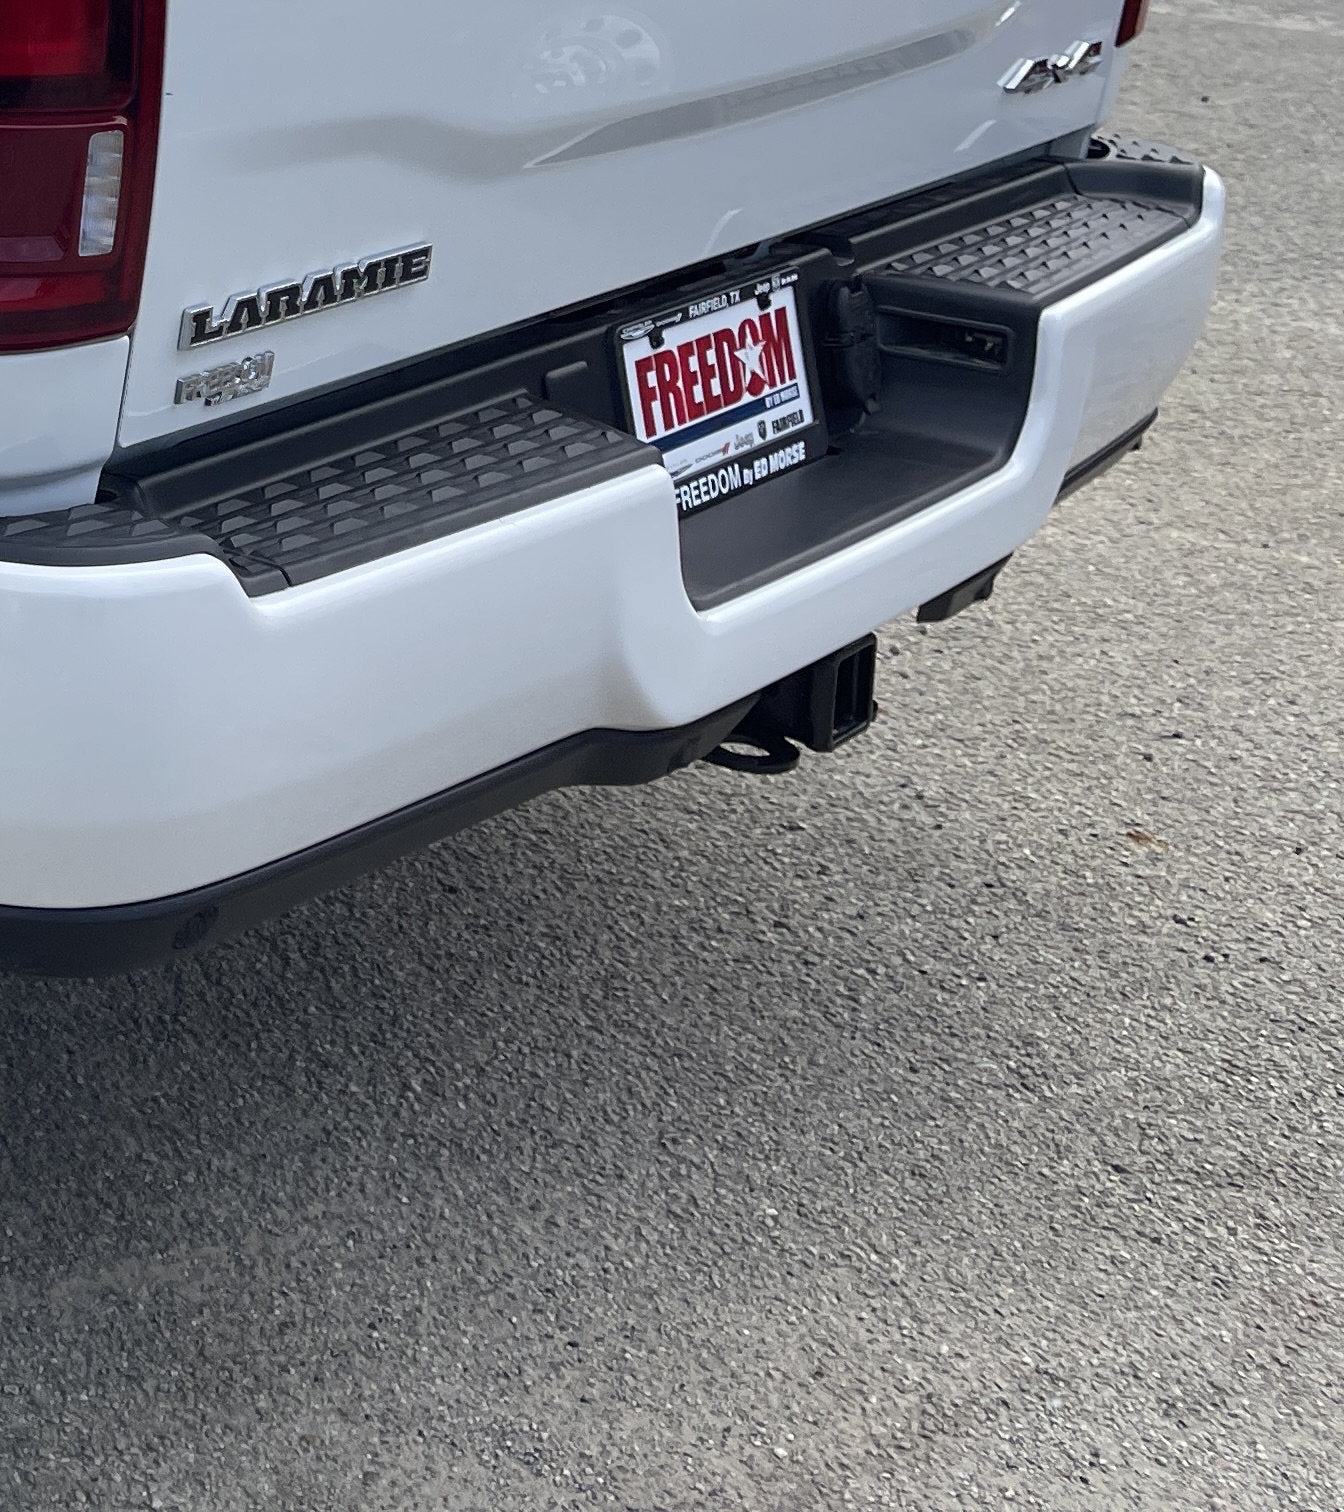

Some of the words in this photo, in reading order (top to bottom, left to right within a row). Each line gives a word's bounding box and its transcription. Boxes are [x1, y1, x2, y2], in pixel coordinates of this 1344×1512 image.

[177, 240, 433, 350] LARAMIE
[635, 306, 797, 440] FREEDOM
[754, 457, 769, 480] ED
[769, 441, 806, 474] MORSE
